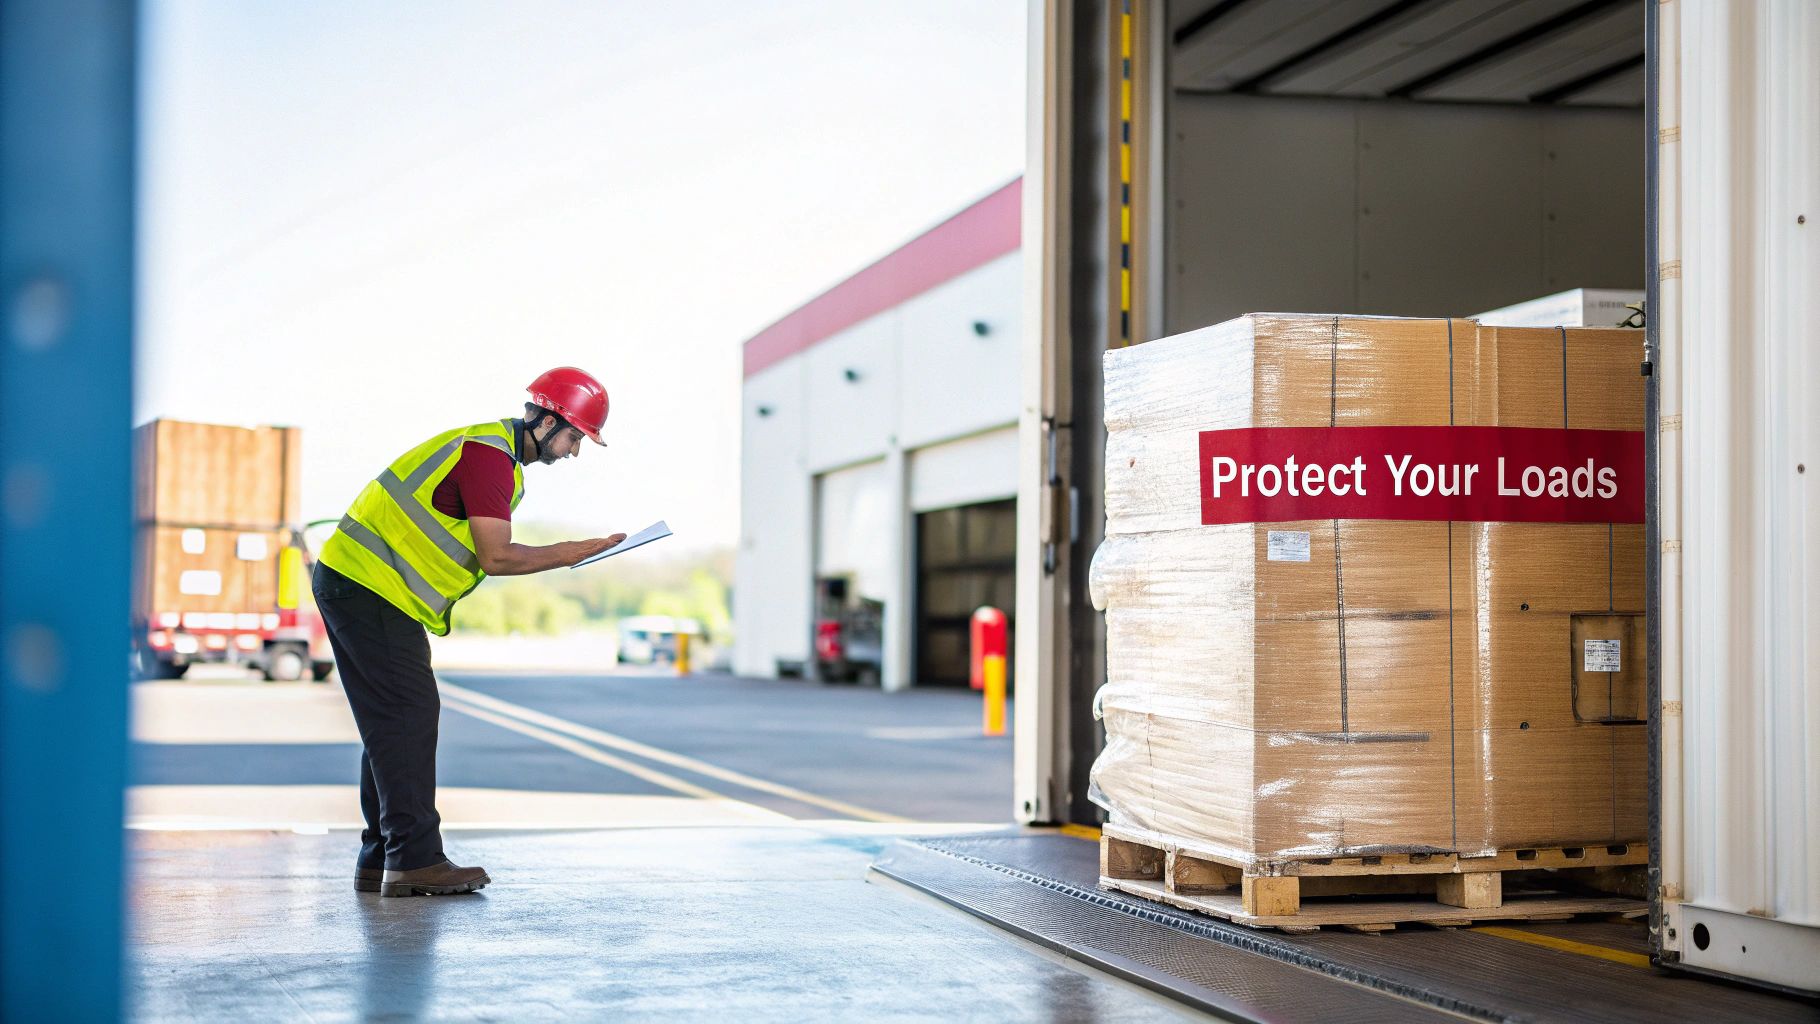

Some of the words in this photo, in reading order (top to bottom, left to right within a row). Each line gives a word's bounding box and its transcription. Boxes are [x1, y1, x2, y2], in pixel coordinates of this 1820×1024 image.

[1212, 454, 1367, 499] Protect
[1384, 454, 1479, 497] Your
[1497, 457, 1618, 499] Loads
